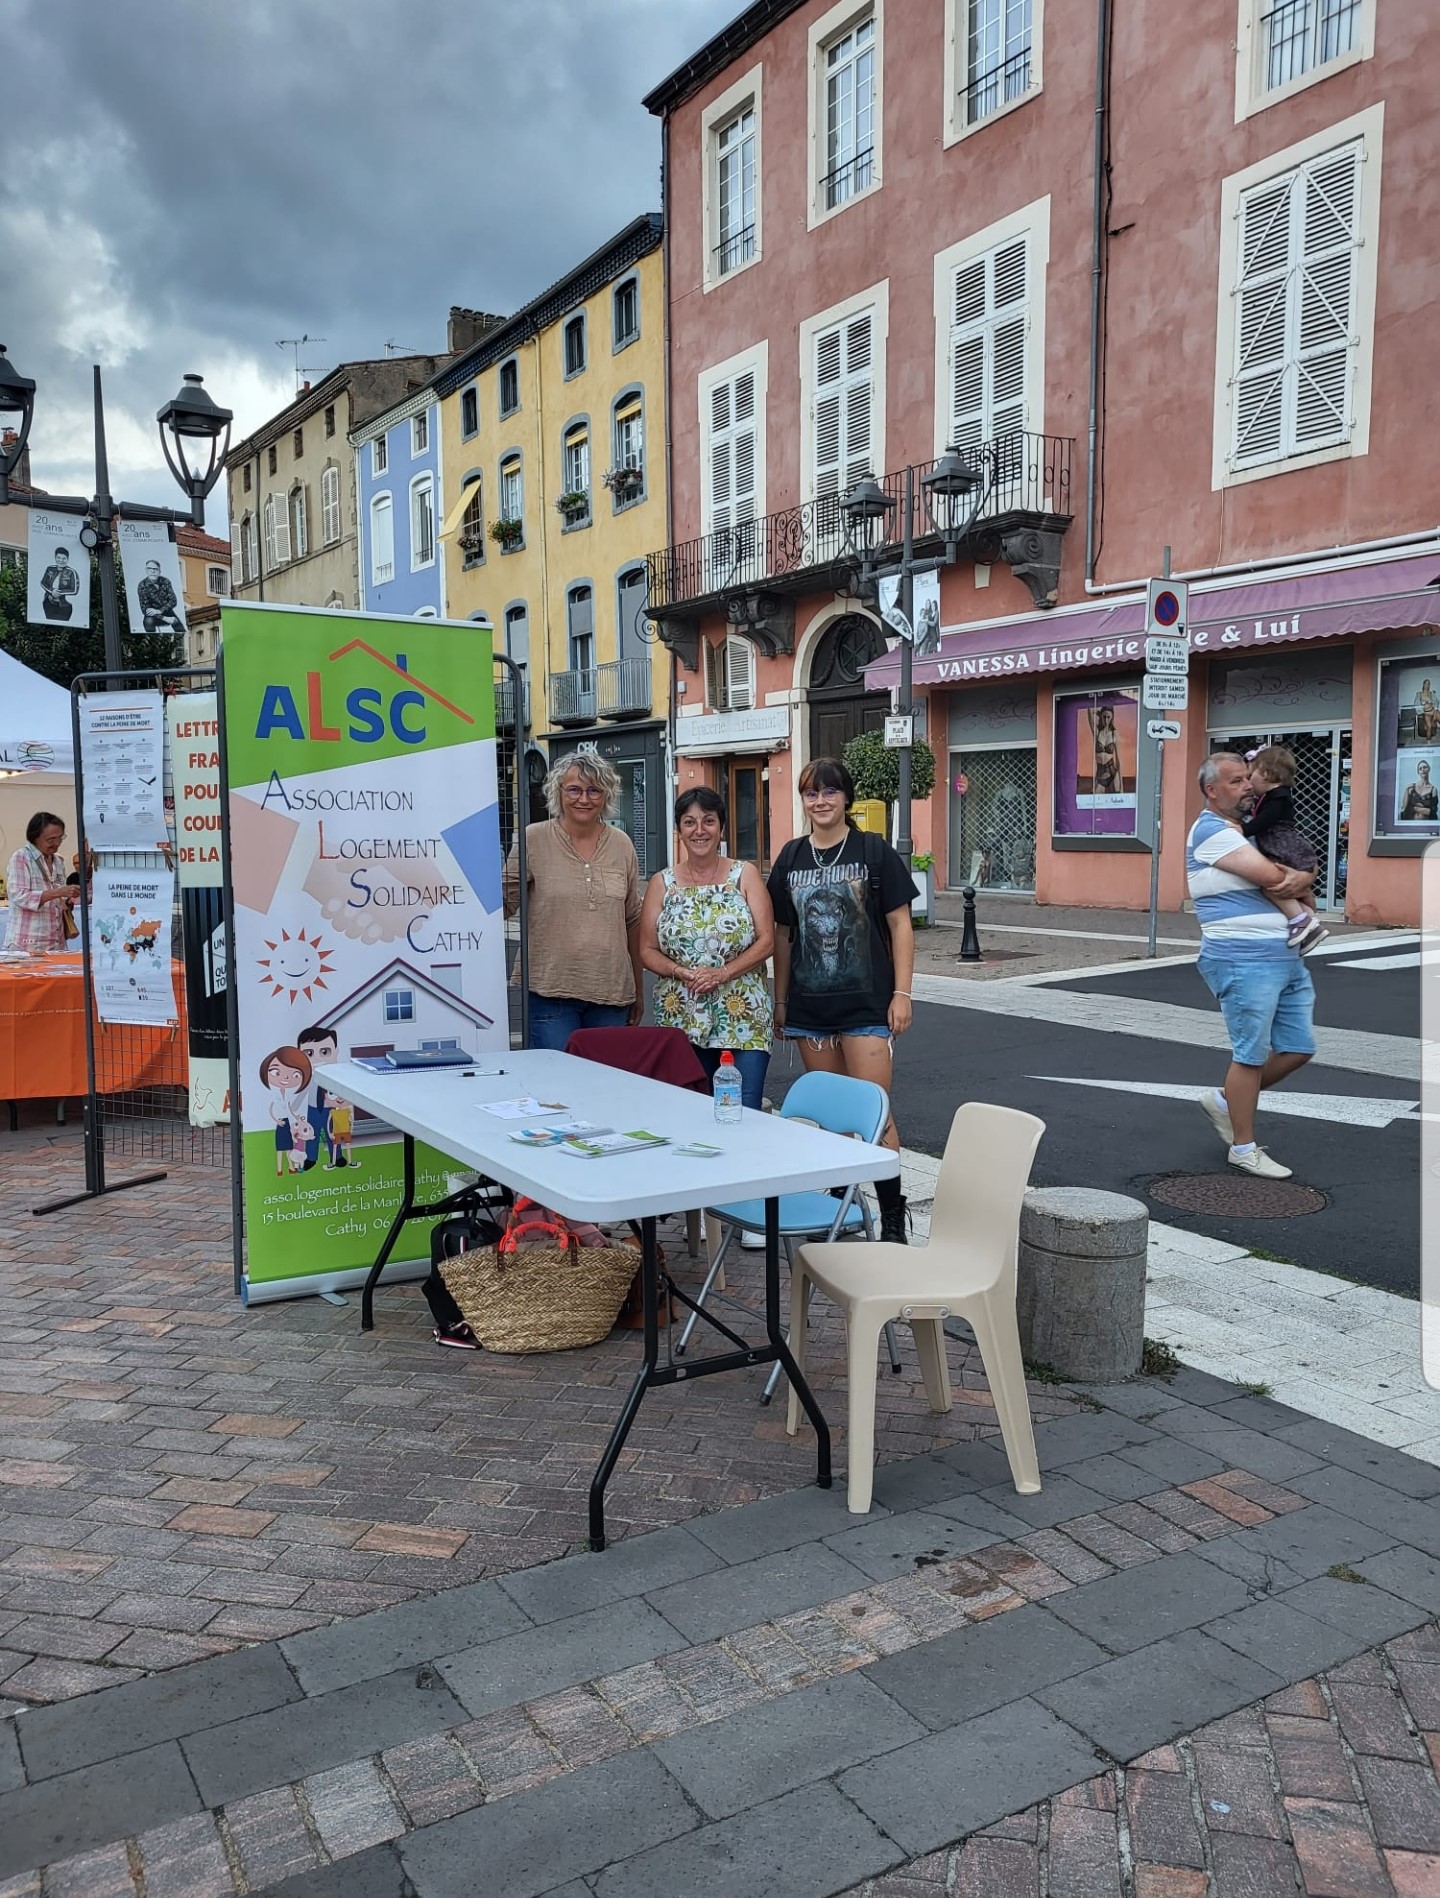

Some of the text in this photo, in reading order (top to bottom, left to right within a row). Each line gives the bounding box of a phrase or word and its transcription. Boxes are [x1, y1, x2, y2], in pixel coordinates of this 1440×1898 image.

[36, 515, 48, 525] 20
[124, 524, 135, 532] 20
[45, 524, 63, 533] ans
[937, 652, 1029, 678] VANESSA
[1038, 641, 1138, 666] Lingerie
[1221, 625, 1240, 643] &
[1255, 615, 1302, 639] Lui
[254, 671, 428, 745] ALSC
[176, 721, 218, 738] LETTR
[189, 752, 219, 768] FRA
[184, 784, 219, 800] POU
[184, 815, 222, 831] COU
[179, 847, 219, 862] DE LA
[787, 862, 869, 889] OWERWOL
[215, 965, 226, 977] QU
[215, 977, 226, 989] TO
[261, 1213, 274, 1226] 15
[276, 1199, 339, 1223] boulevard
[342, 1199, 357, 1213] de
[361, 1197, 371, 1211] la
[325, 1218, 367, 1238] Cathy
[373, 1215, 391, 1230] 06
